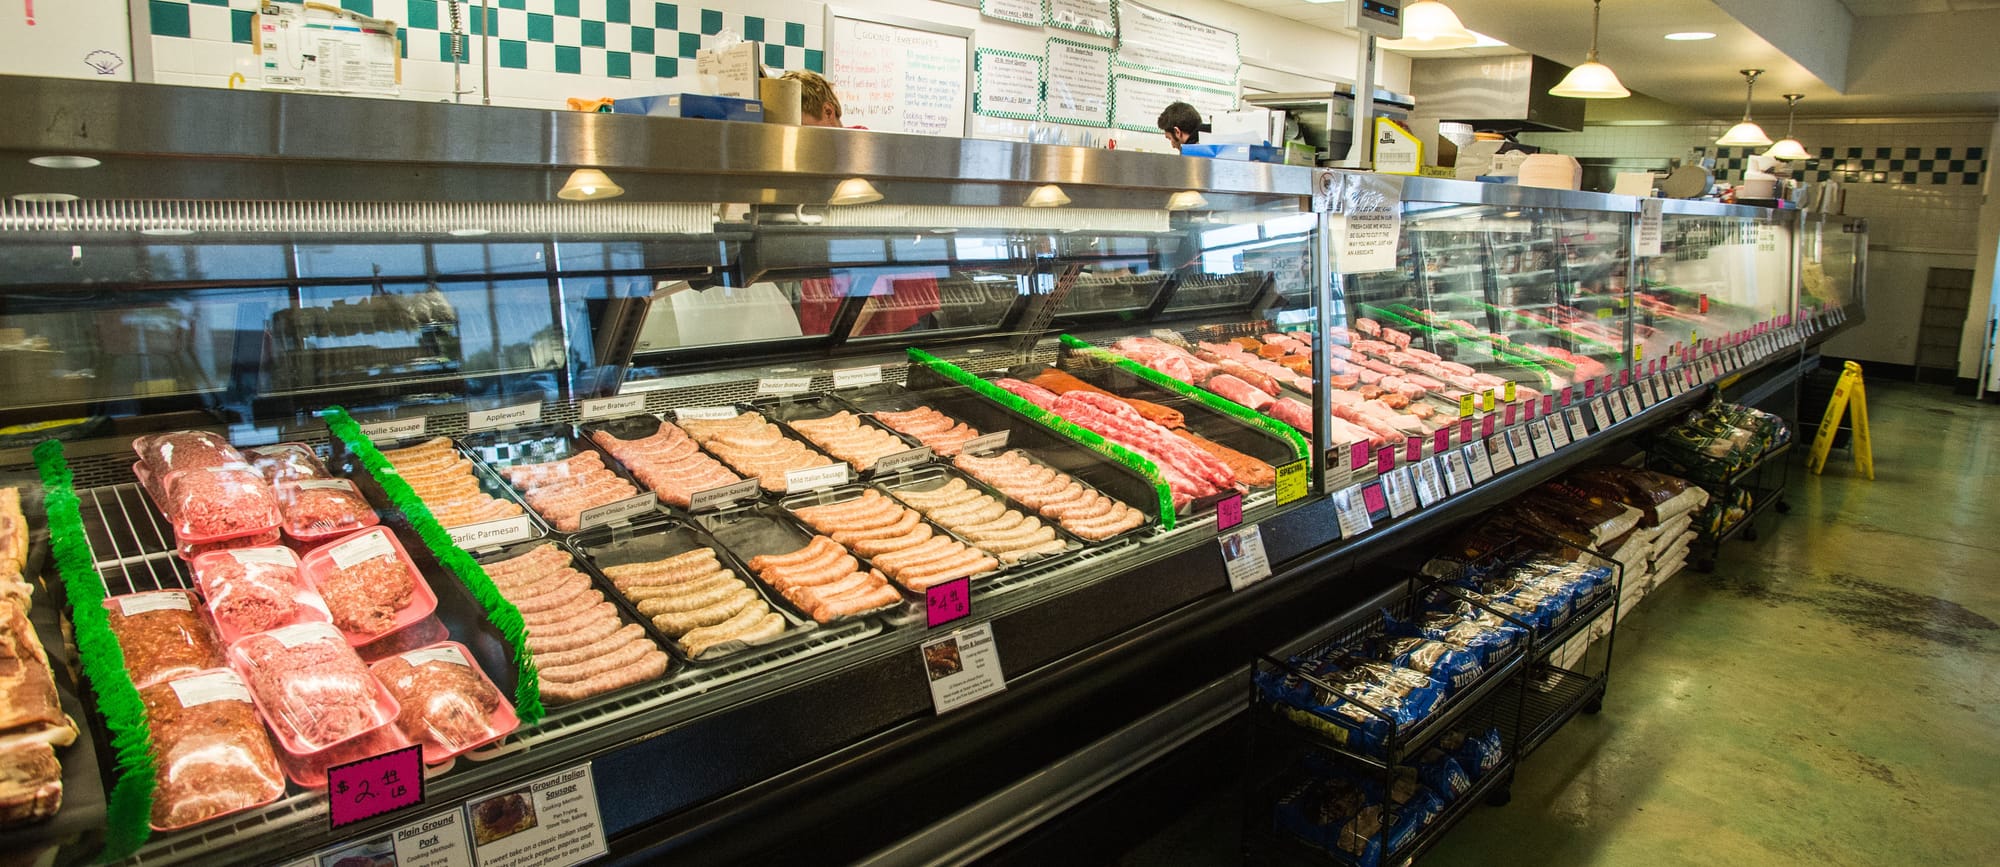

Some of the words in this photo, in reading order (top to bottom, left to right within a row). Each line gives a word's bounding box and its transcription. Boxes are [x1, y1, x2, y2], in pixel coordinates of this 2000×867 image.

[592, 403, 606, 412] Beer
[607, 400, 636, 409] Bratwurst
[486, 410, 526, 422] Applewurst
[361, 425, 388, 436] douille
[389, 423, 420, 434] Sausage
[1280, 463, 1304, 477] SPECIAL
[694, 495, 707, 504] Hot
[708, 490, 728, 501] Italian
[729, 485, 755, 496] Sausage
[585, 511, 604, 521] Green
[606, 506, 625, 516] Onion
[627, 500, 651, 510] Sausage
[452, 533, 476, 544] Garlic
[478, 525, 519, 539] Parmesan
[532, 776, 561, 792] Ground
[561, 769, 586, 783] Italian
[391, 785, 407, 798] LB
[546, 783, 577, 800] Sausage
[542, 802, 561, 812] Cooking
[562, 807, 578, 817] Frying
[572, 812, 587, 821] Baking
[398, 826, 421, 841] Plain
[422, 814, 455, 832] Ground
[419, 834, 439, 849] Pork
[490, 854, 508, 864] sweet
[509, 847, 522, 858] take
[524, 845, 531, 853] on
[538, 836, 556, 848] classic
[558, 830, 576, 842] Italian
[517, 853, 533, 864] black
[558, 837, 579, 850] paprika
[580, 832, 591, 841] and
[406, 850, 429, 863] Cooking
[543, 851, 561, 865] flavor
[569, 847, 580, 856] any
[580, 840, 595, 852] dish!
